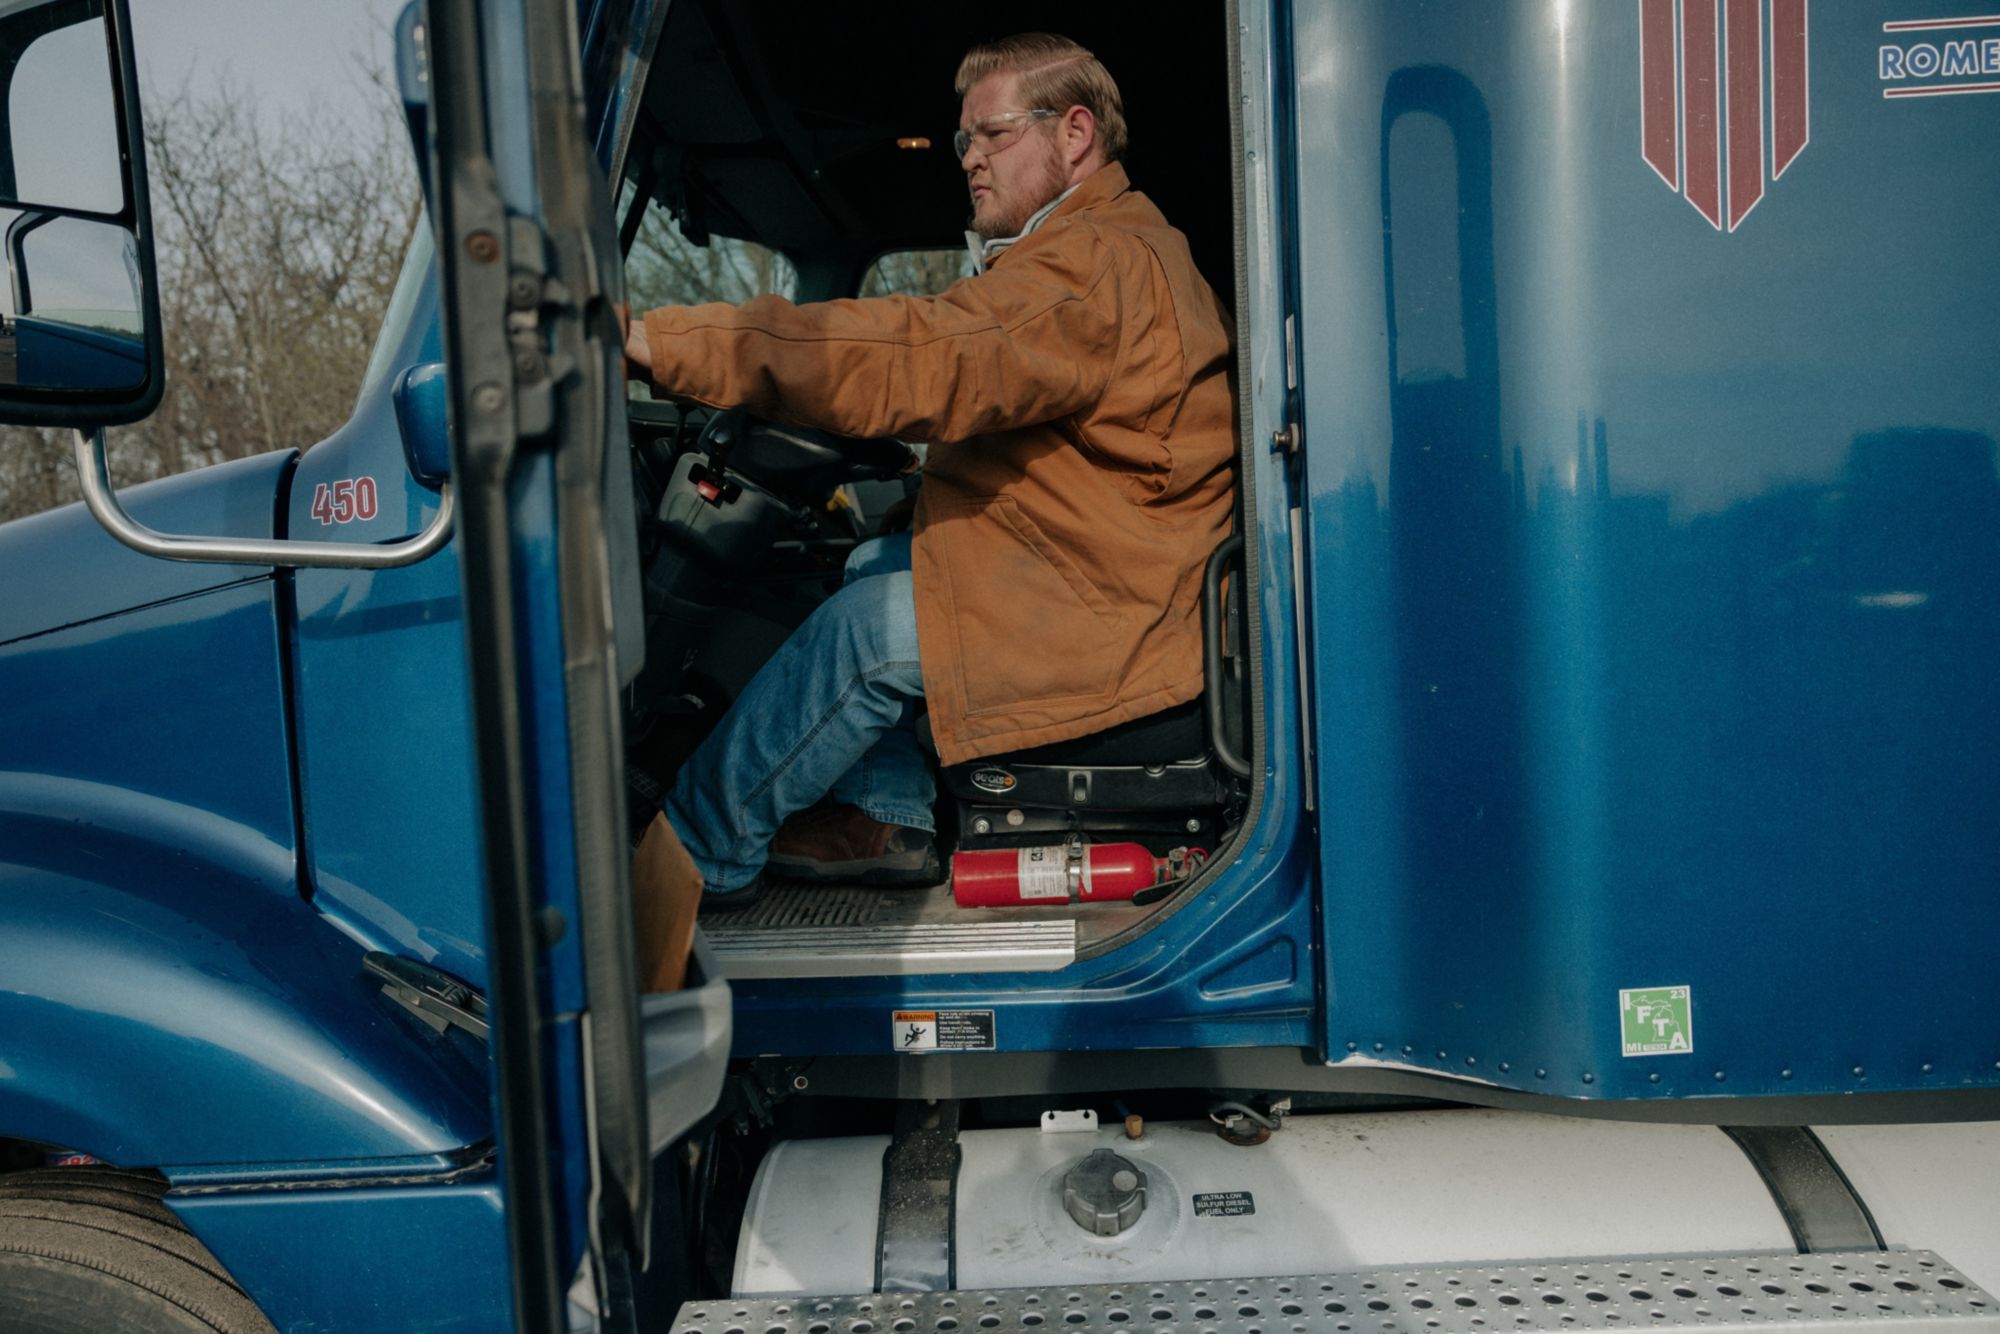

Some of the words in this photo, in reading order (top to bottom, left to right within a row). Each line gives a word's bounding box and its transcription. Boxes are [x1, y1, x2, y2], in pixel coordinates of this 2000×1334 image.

[1879, 39, 2000, 79] ROME
[311, 476, 378, 525] 450
[1670, 989, 1686, 999] 23
[1626, 1042, 1642, 1053] MI
[1195, 1200, 1225, 1208] SULFUR
